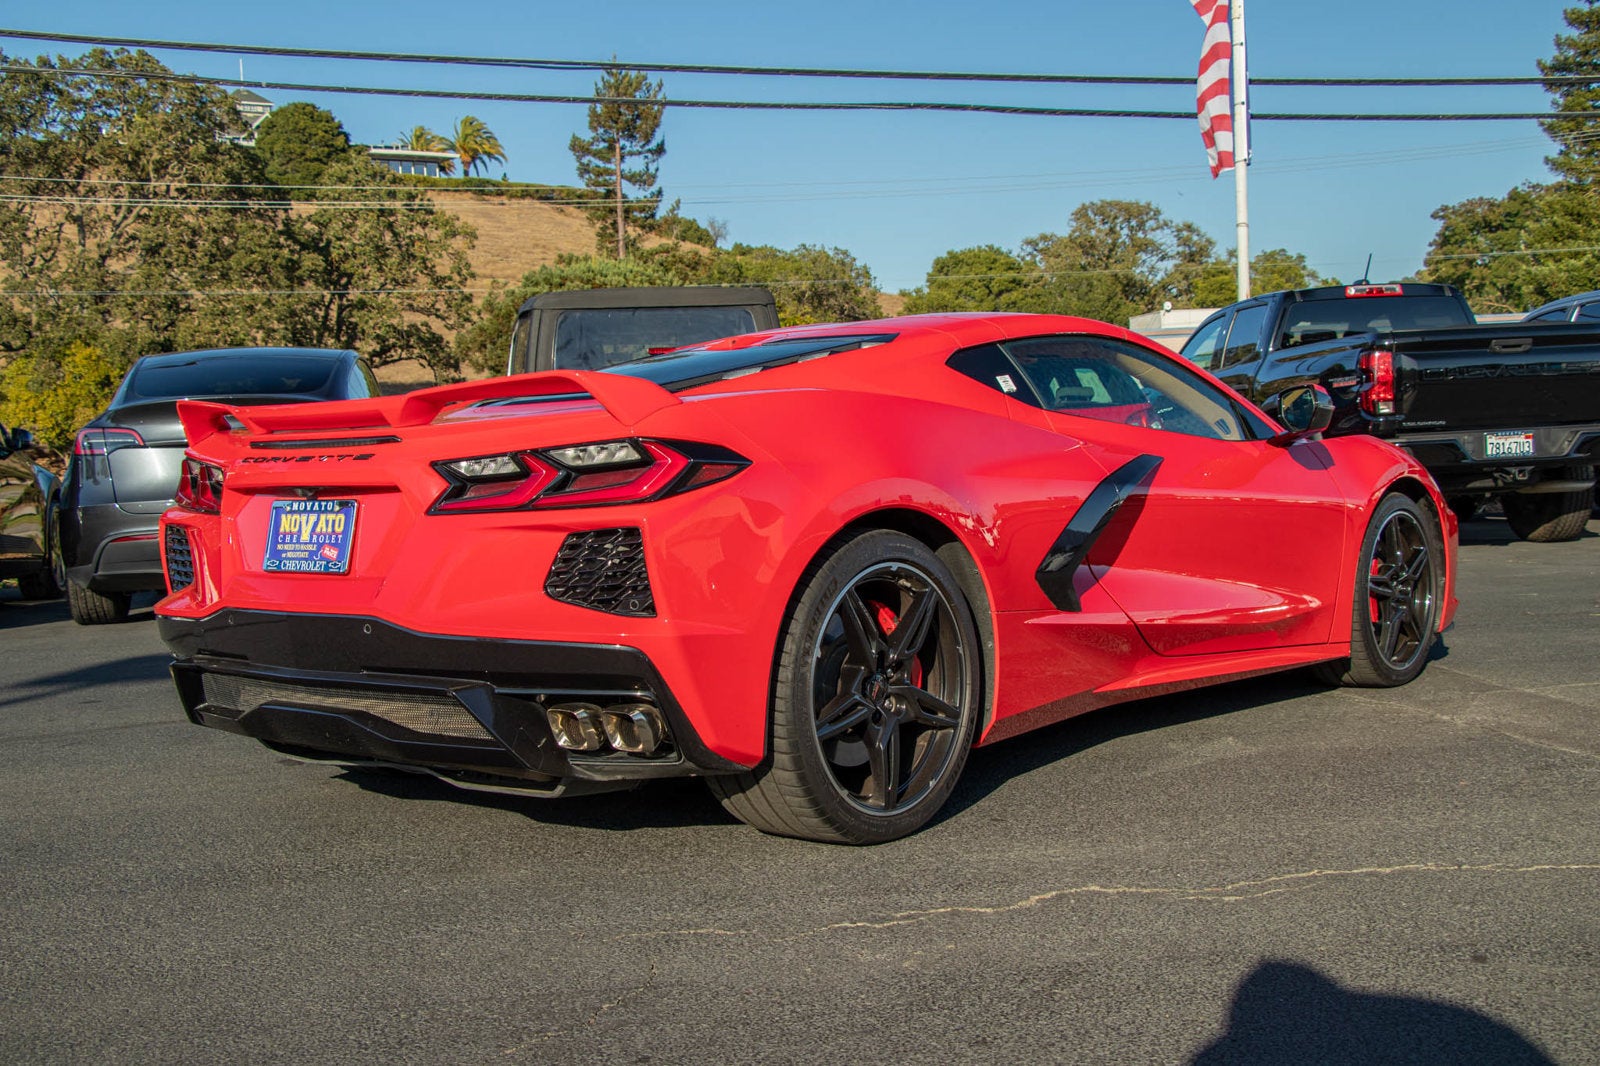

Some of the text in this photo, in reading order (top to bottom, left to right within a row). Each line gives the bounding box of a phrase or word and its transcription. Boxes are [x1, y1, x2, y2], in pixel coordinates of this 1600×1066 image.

[1489, 441, 1531, 454] 78167U3
[241, 454, 376, 464] CORVETTE
[292, 502, 333, 511] NOVATO
[280, 514, 346, 541] NOVATO
[280, 560, 326, 570] CHEVROLET
